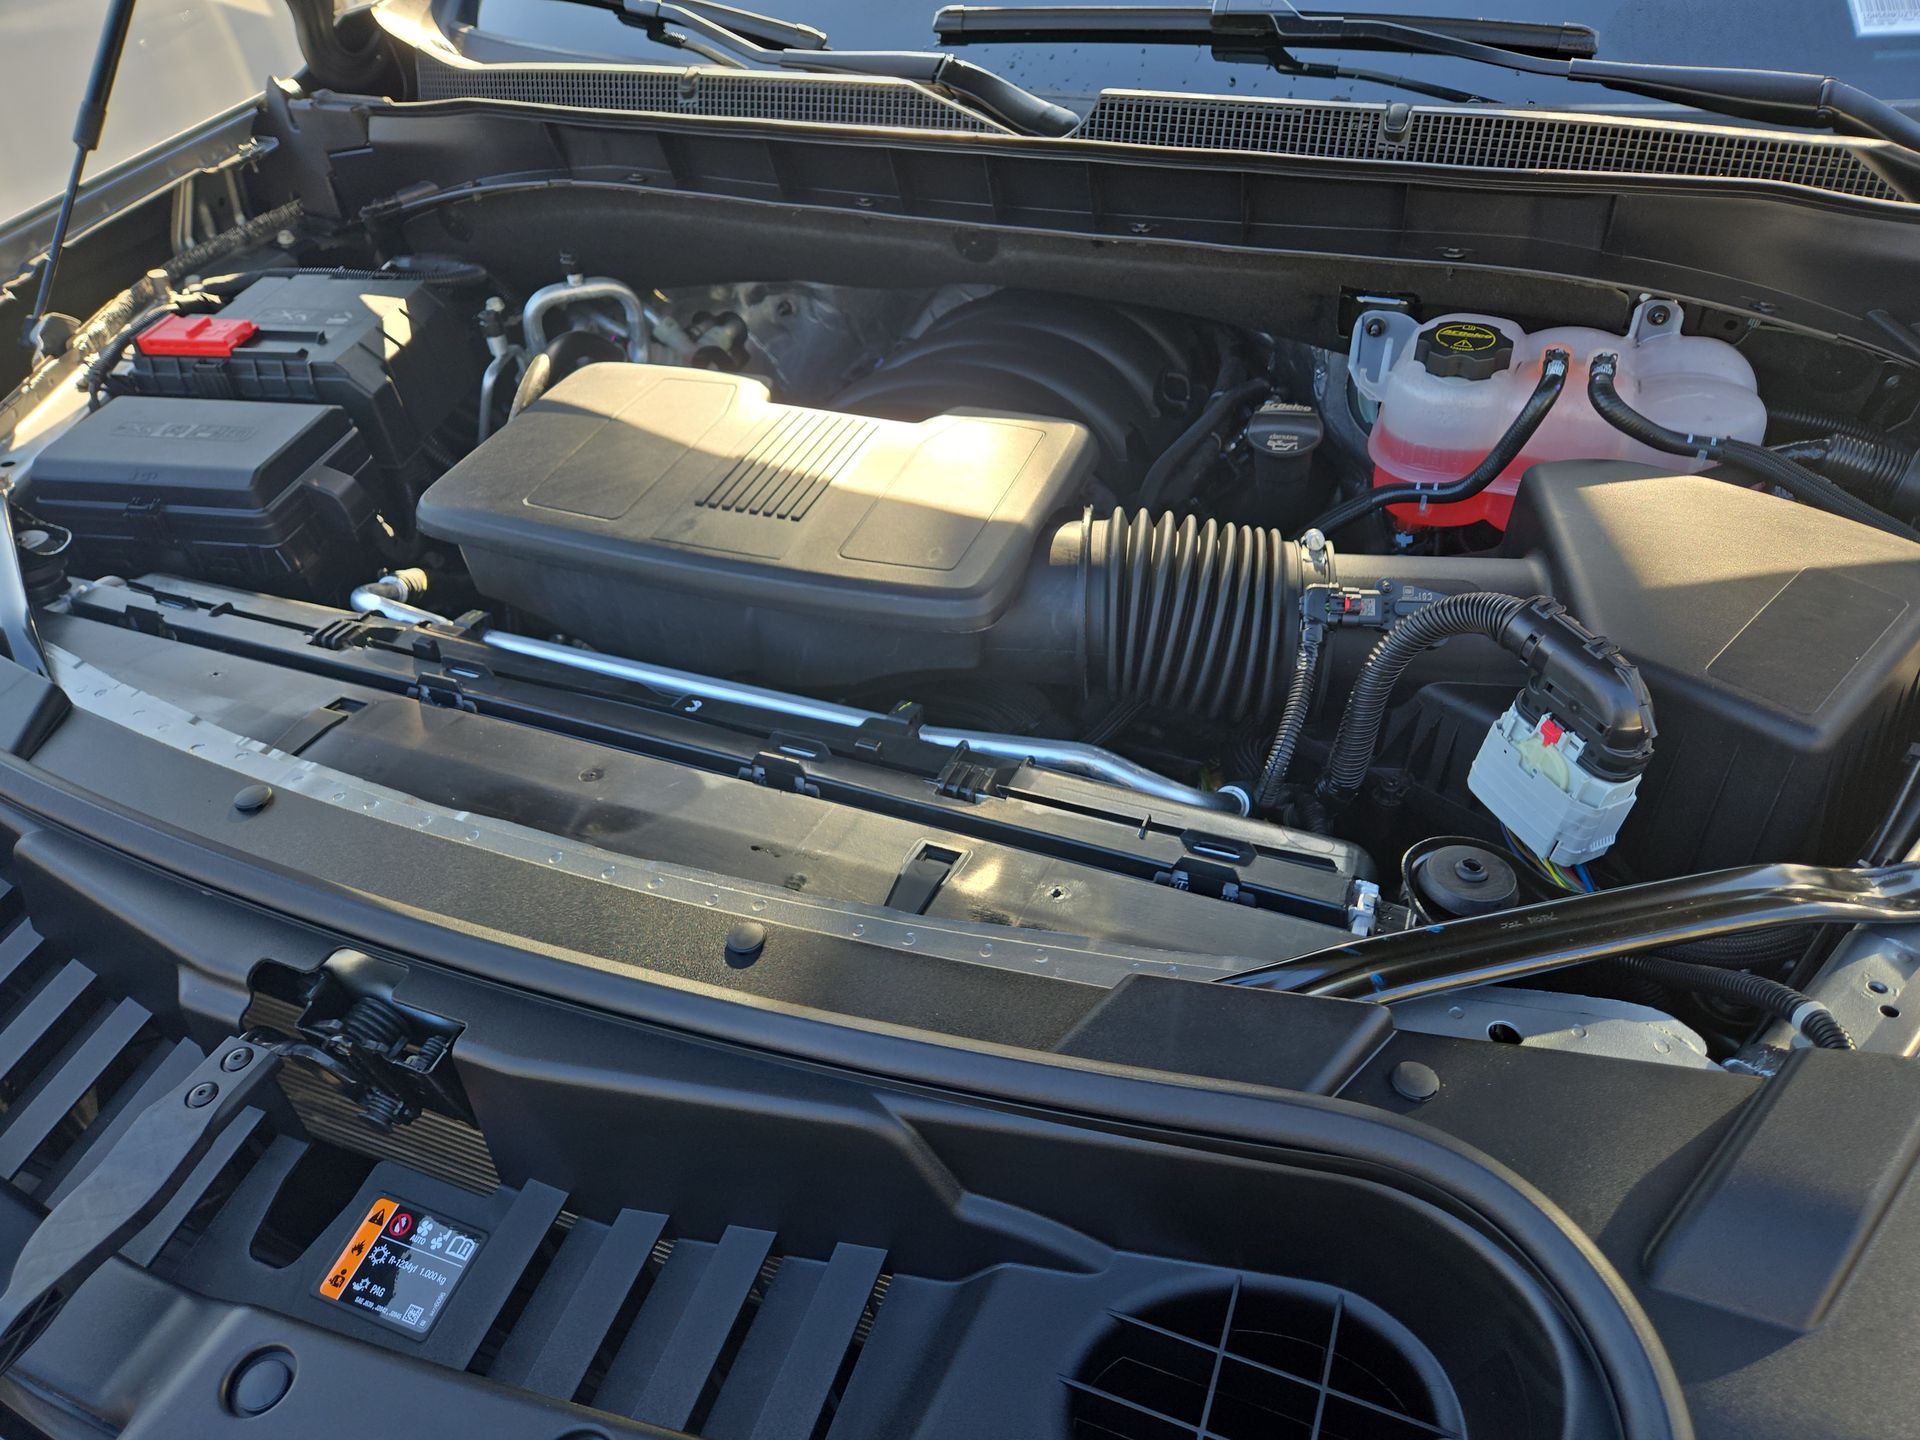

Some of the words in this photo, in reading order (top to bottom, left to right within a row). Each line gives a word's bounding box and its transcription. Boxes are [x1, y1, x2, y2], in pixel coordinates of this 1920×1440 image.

[1260, 402, 1312, 412] ACDelco
[409, 1234, 426, 1245] AUTO
[388, 1255, 419, 1273] R-1234yf
[419, 1267, 438, 1281] 1.000
[436, 1273, 447, 1286] kg
[370, 1284, 386, 1298] PAG
